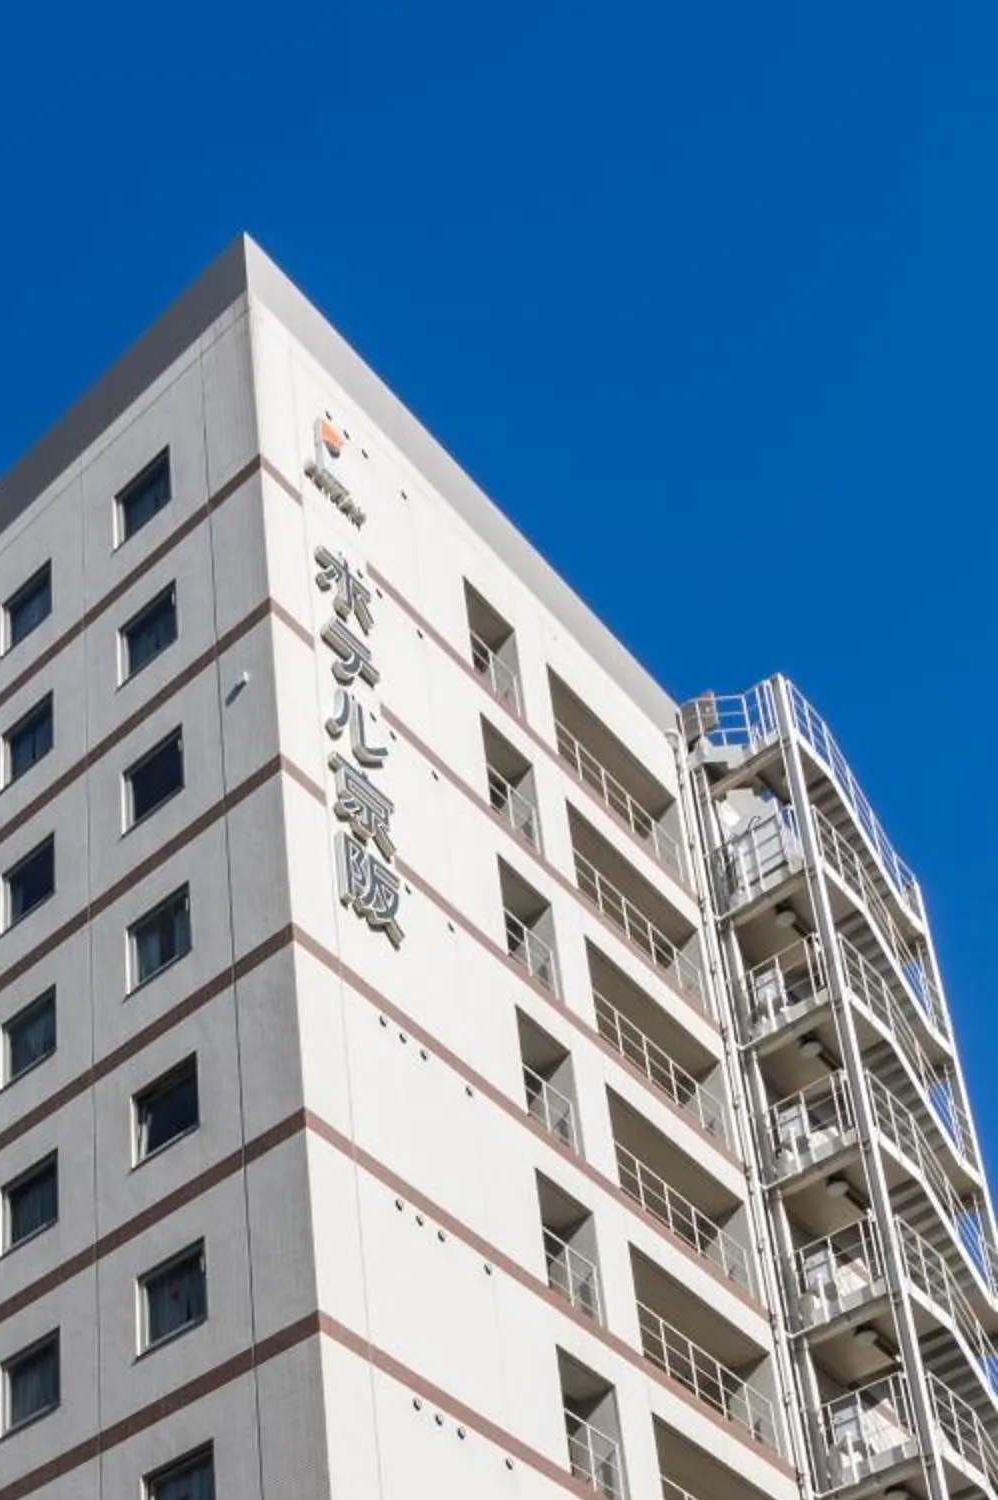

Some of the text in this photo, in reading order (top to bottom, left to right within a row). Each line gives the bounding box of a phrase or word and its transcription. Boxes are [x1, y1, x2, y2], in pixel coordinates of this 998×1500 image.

[313, 545, 405, 951] ホテル京阪
